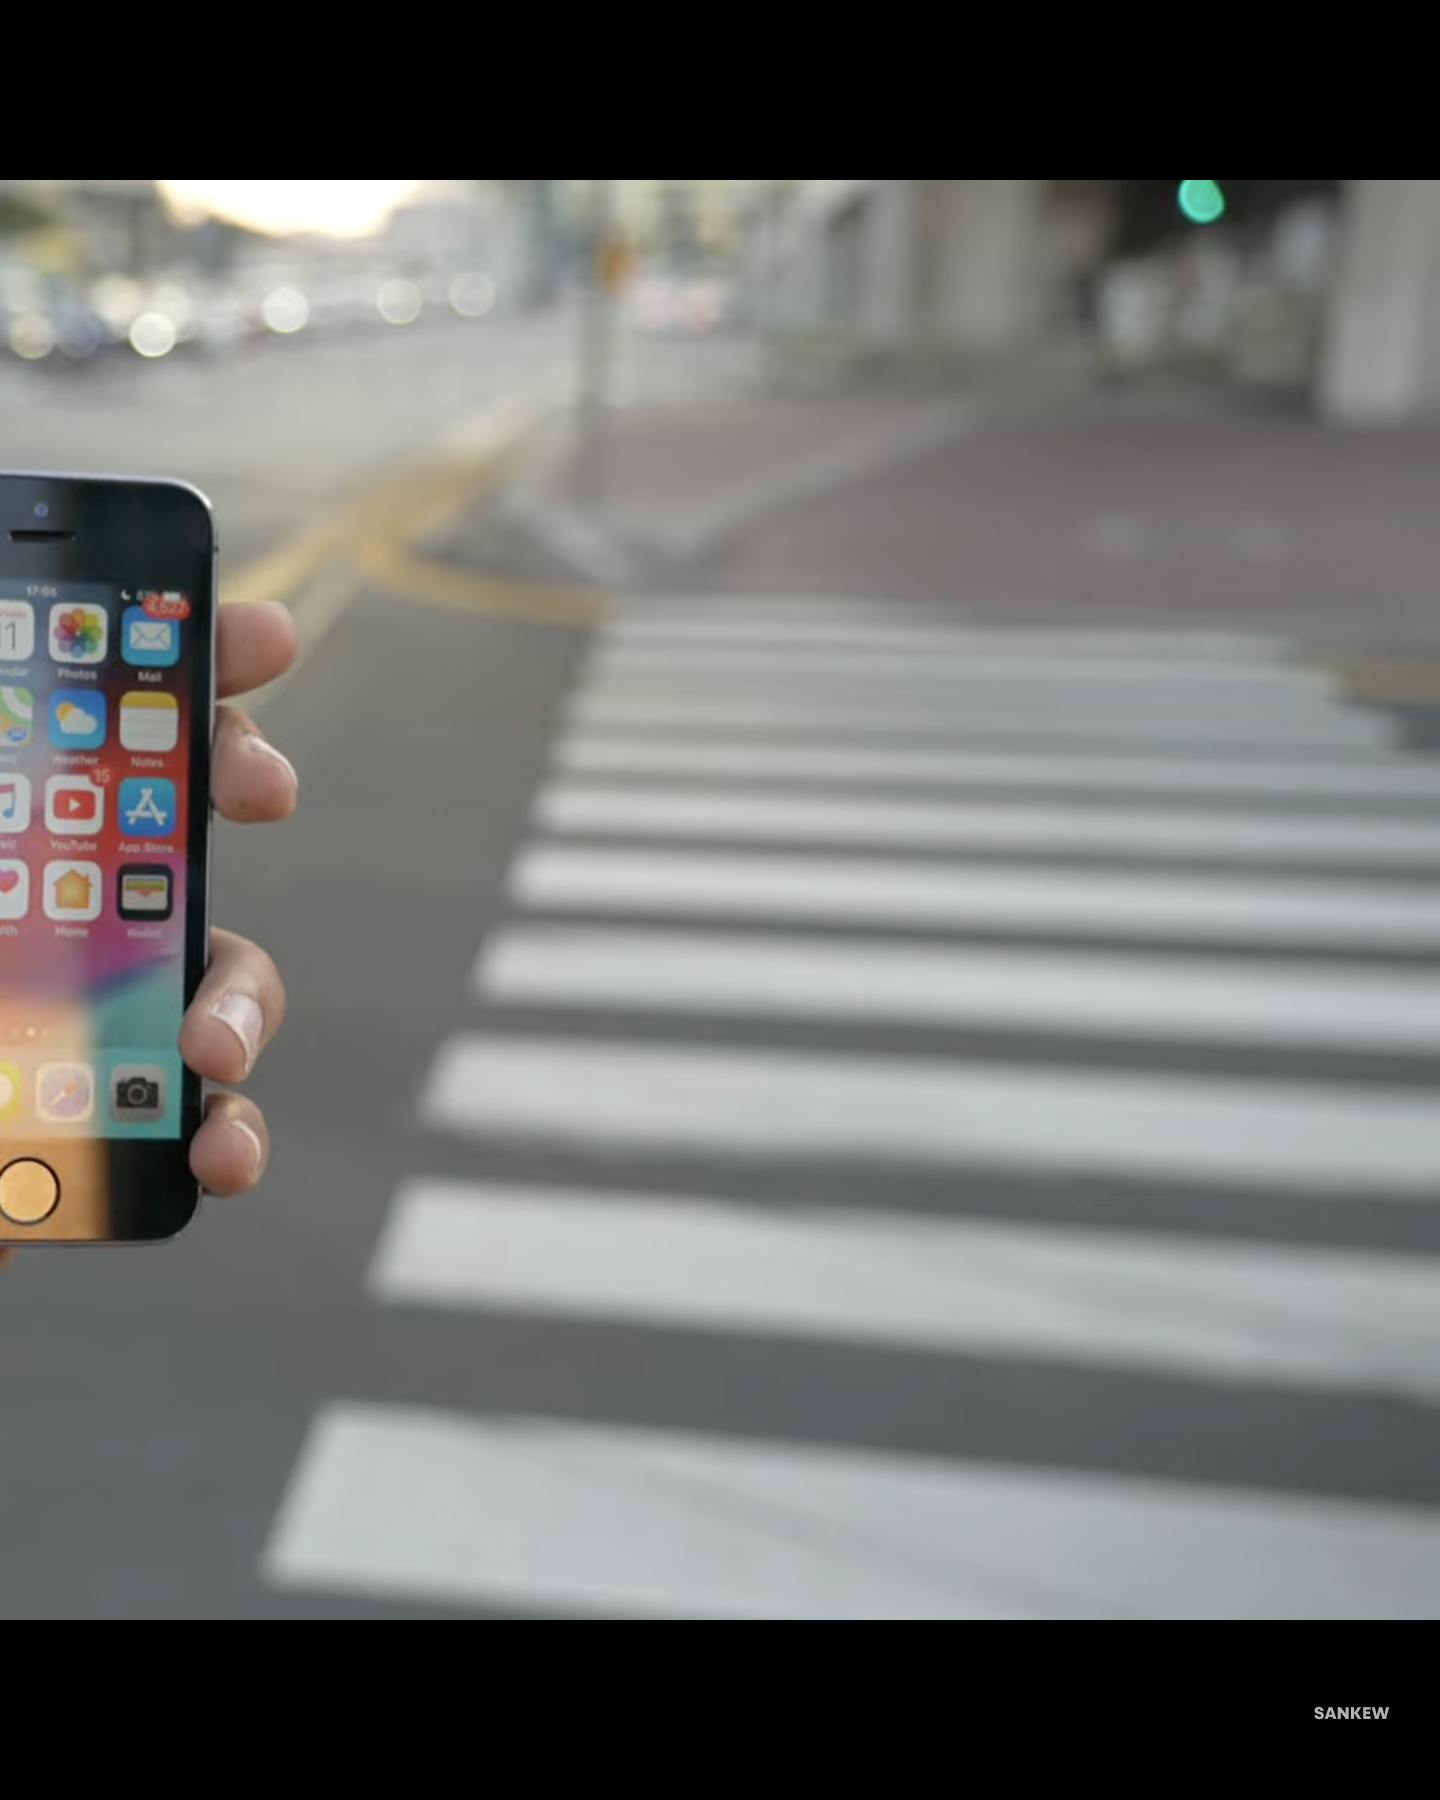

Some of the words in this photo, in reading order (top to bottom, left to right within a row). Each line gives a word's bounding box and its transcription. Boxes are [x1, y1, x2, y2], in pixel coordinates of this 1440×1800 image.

[57, 668, 98, 680] Photos
[138, 671, 162, 682] Mail
[52, 754, 99, 766] Weather
[131, 757, 164, 768] Notes
[95, 770, 110, 783] 15
[50, 839, 98, 852] YouTube
[118, 842, 141, 855] App
[144, 843, 174, 854] Store
[55, 926, 90, 938] Home
